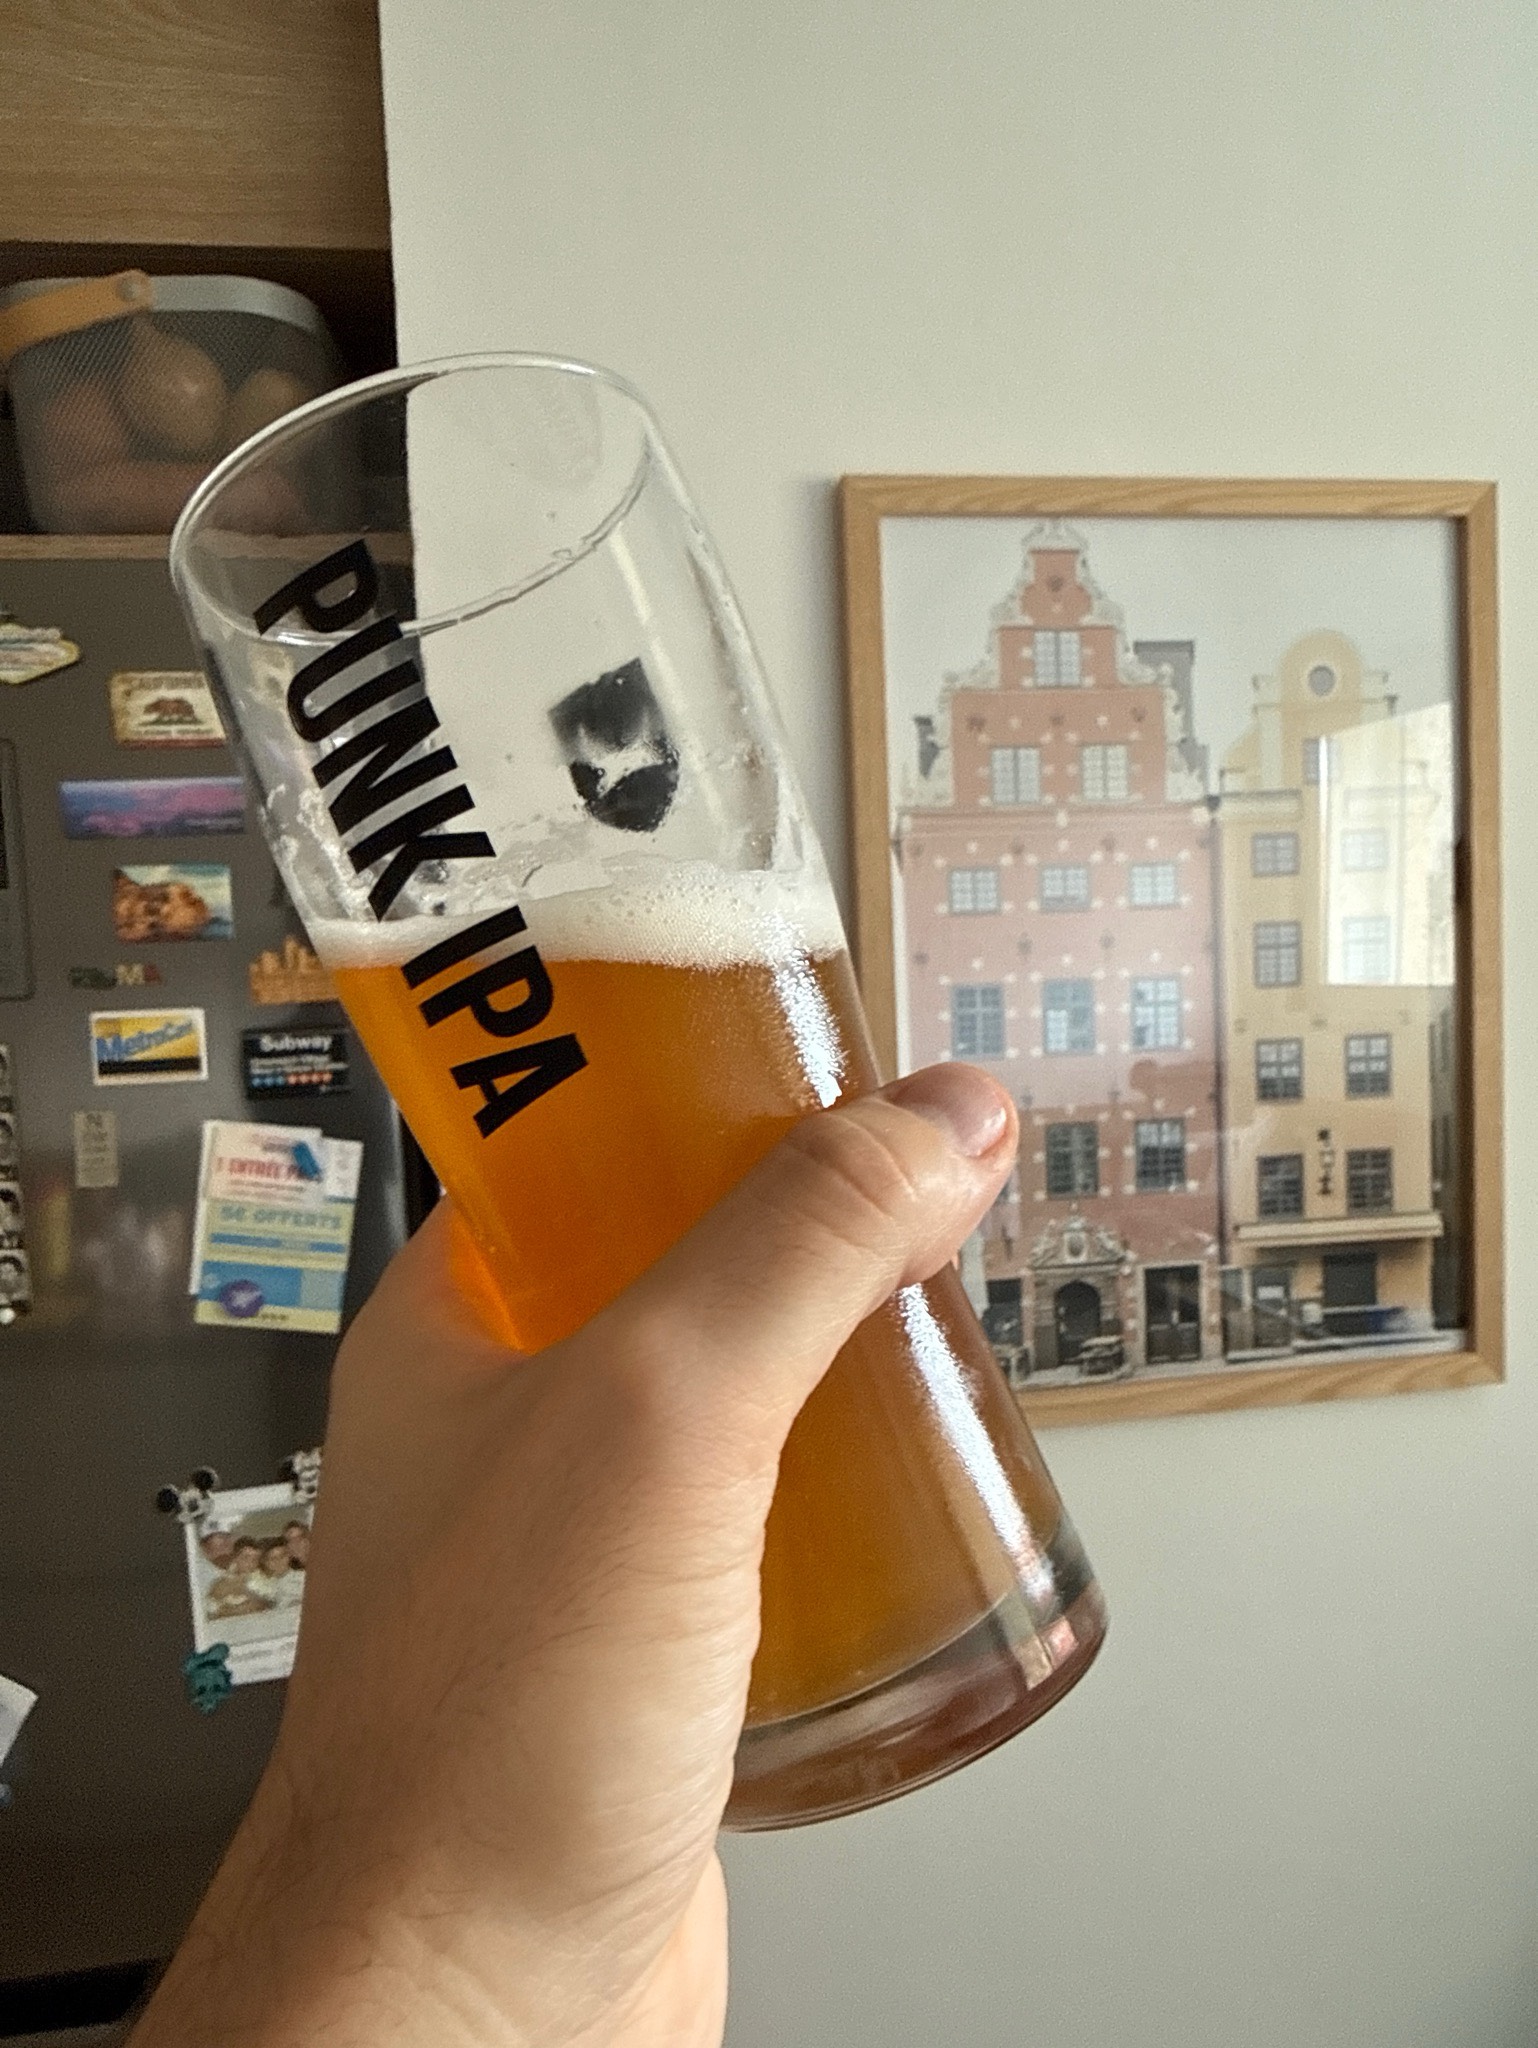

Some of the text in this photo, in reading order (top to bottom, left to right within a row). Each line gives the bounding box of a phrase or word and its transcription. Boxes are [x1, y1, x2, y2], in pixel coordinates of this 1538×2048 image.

[253, 539, 496, 923] PUNK
[401, 905, 589, 1139] IPA
[260, 1033, 332, 1053] Subway
